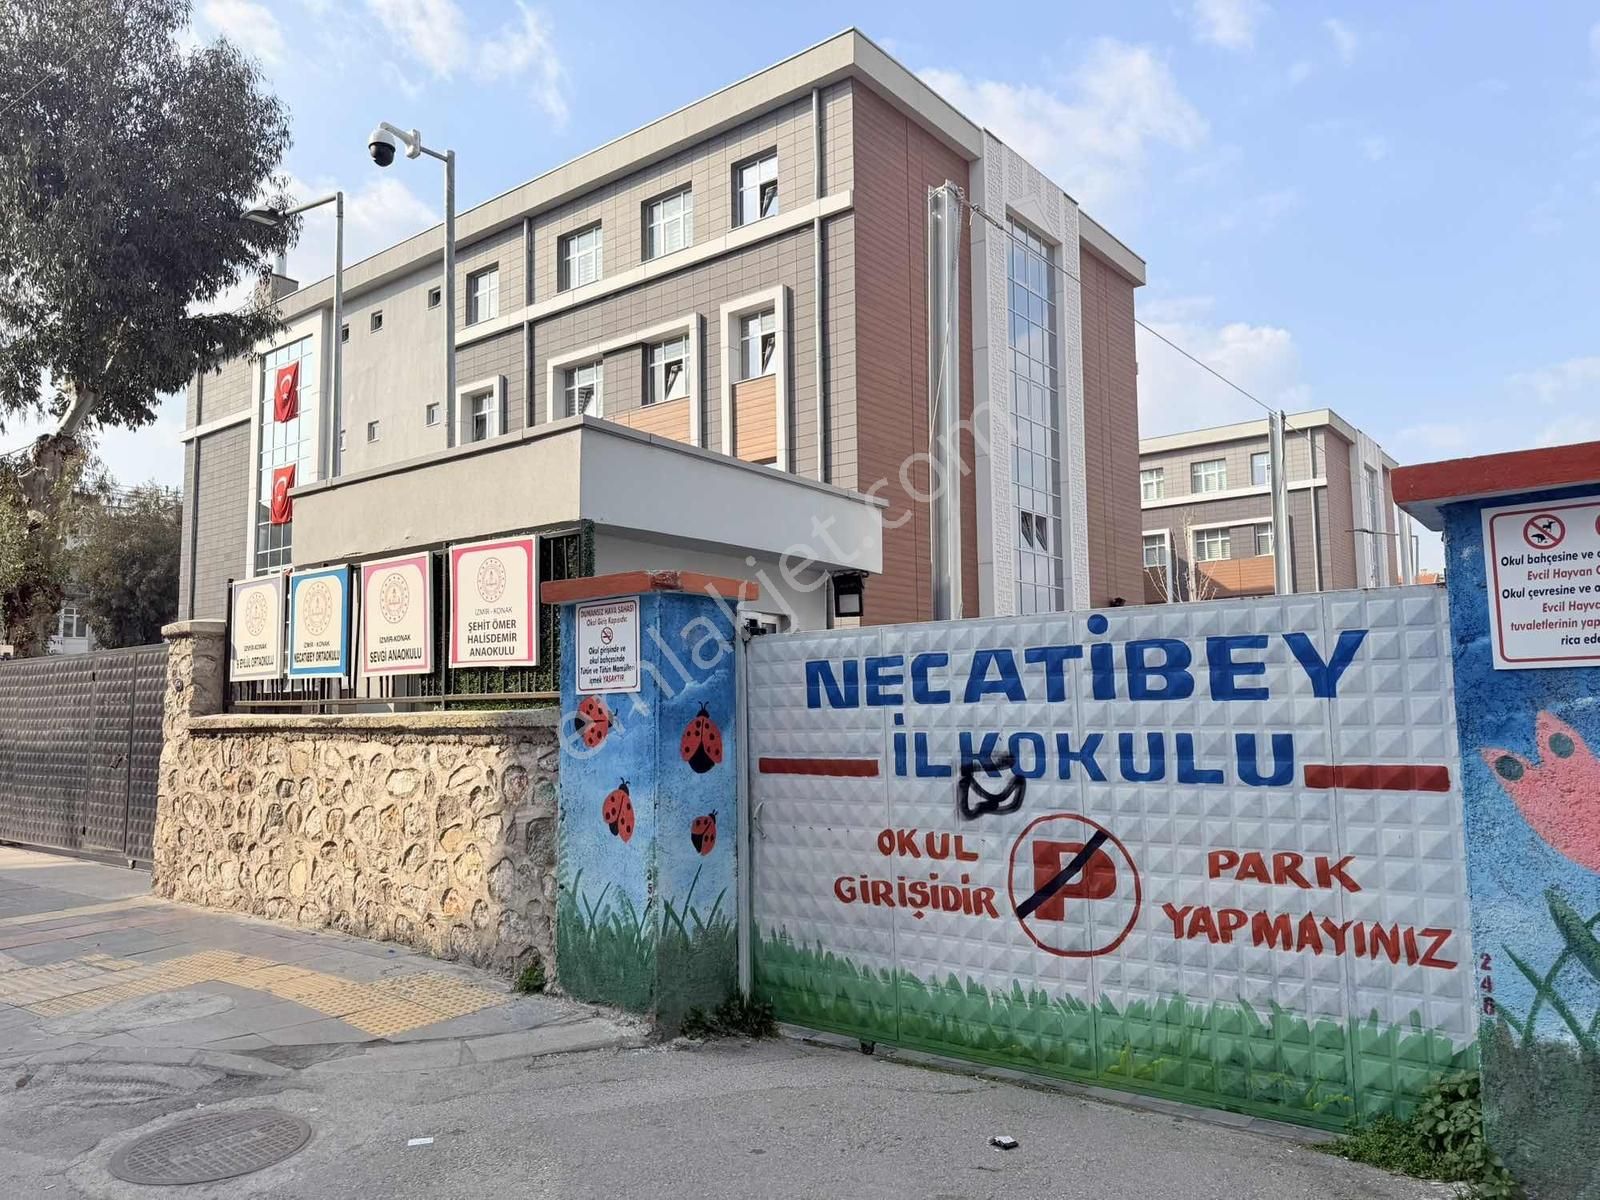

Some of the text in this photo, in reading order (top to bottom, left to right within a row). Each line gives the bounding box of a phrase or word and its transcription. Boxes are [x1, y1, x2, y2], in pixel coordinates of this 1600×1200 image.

[1501, 554, 1524, 567] Okul
[1527, 551, 1578, 565] bahçesine
[1581, 551, 1594, 559] ve
[1527, 568, 1550, 580] Evcil
[1553, 567, 1592, 580] Hayvan
[1502, 587, 1525, 599] Okul
[1528, 585, 1576, 600] çevresine
[1579, 585, 1591, 593] ve
[494, 606, 512, 615] KONAK
[581, 608, 604, 618] DUMANSIZ
[1542, 601, 1565, 612] Evcil
[468, 618, 517, 634] ŞEHİT ÖMER
[1511, 618, 1578, 631] tuvaletlerinin
[467, 631, 517, 644] HALİSDEMİR
[1561, 635, 1581, 645] rica
[370, 647, 422, 663] SEVGİ ANAOKULU
[469, 646, 515, 657] ANAOKULU
[589, 646, 599, 655] Okul
[600, 645, 619, 656] girişinde
[589, 655, 625, 664] okul bahçesinde
[804, 613, 1369, 709] NECATİBEY
[894, 712, 1294, 787] İLKOKULU
[876, 827, 979, 863] OKUL
[1208, 848, 1362, 894] PARK
[834, 872, 999, 921] GİRİŞİDİR
[1161, 901, 1461, 971] YAPMAYINIZ
